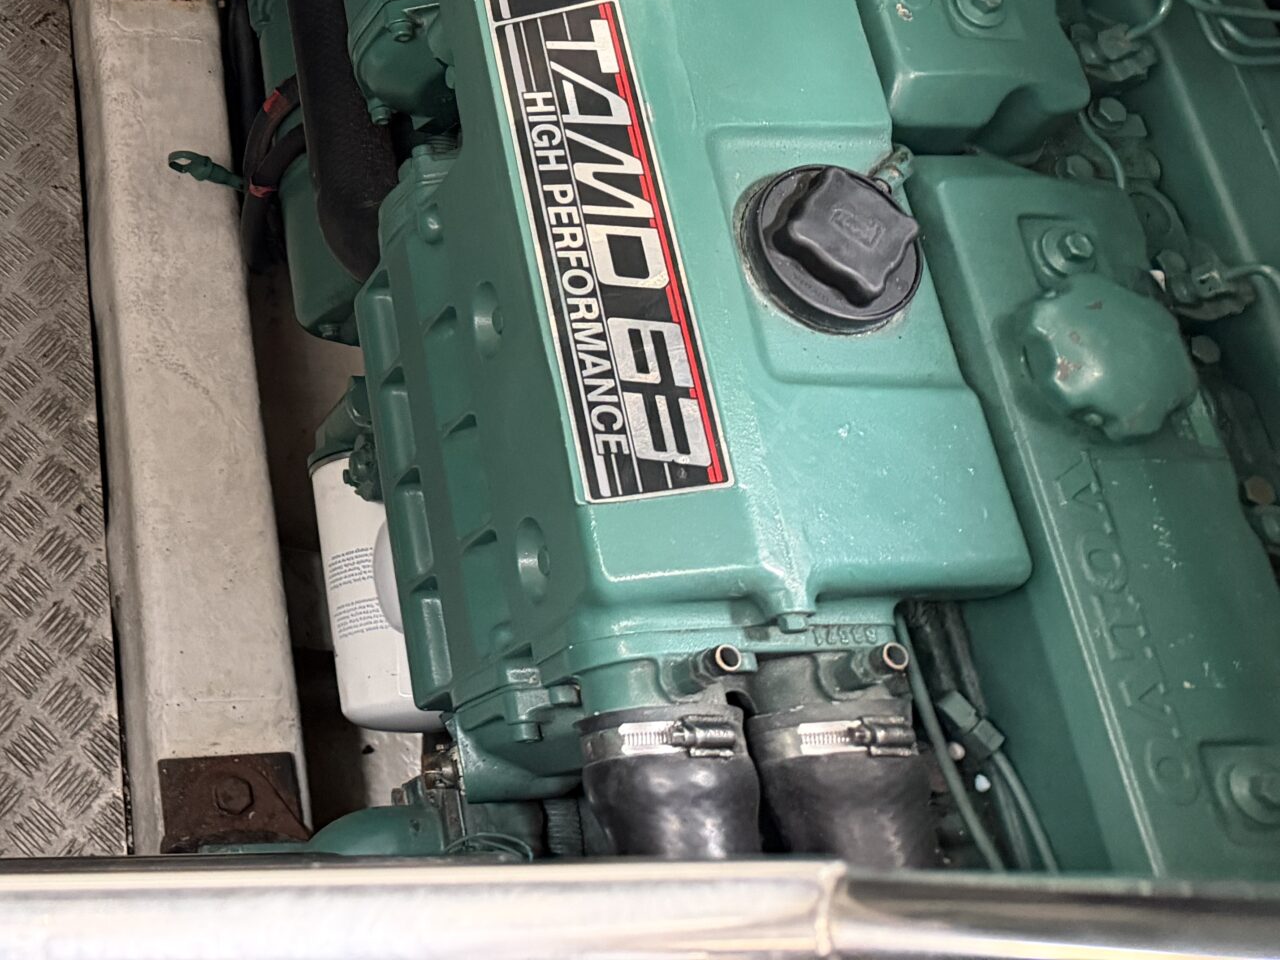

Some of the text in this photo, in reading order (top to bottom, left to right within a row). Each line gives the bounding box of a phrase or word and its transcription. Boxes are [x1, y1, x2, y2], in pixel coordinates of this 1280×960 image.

[522, 90, 630, 457] HIGH PERFORMANCE
[544, 19, 670, 290] TAMD
[1055, 450, 1200, 804] VOLVO
